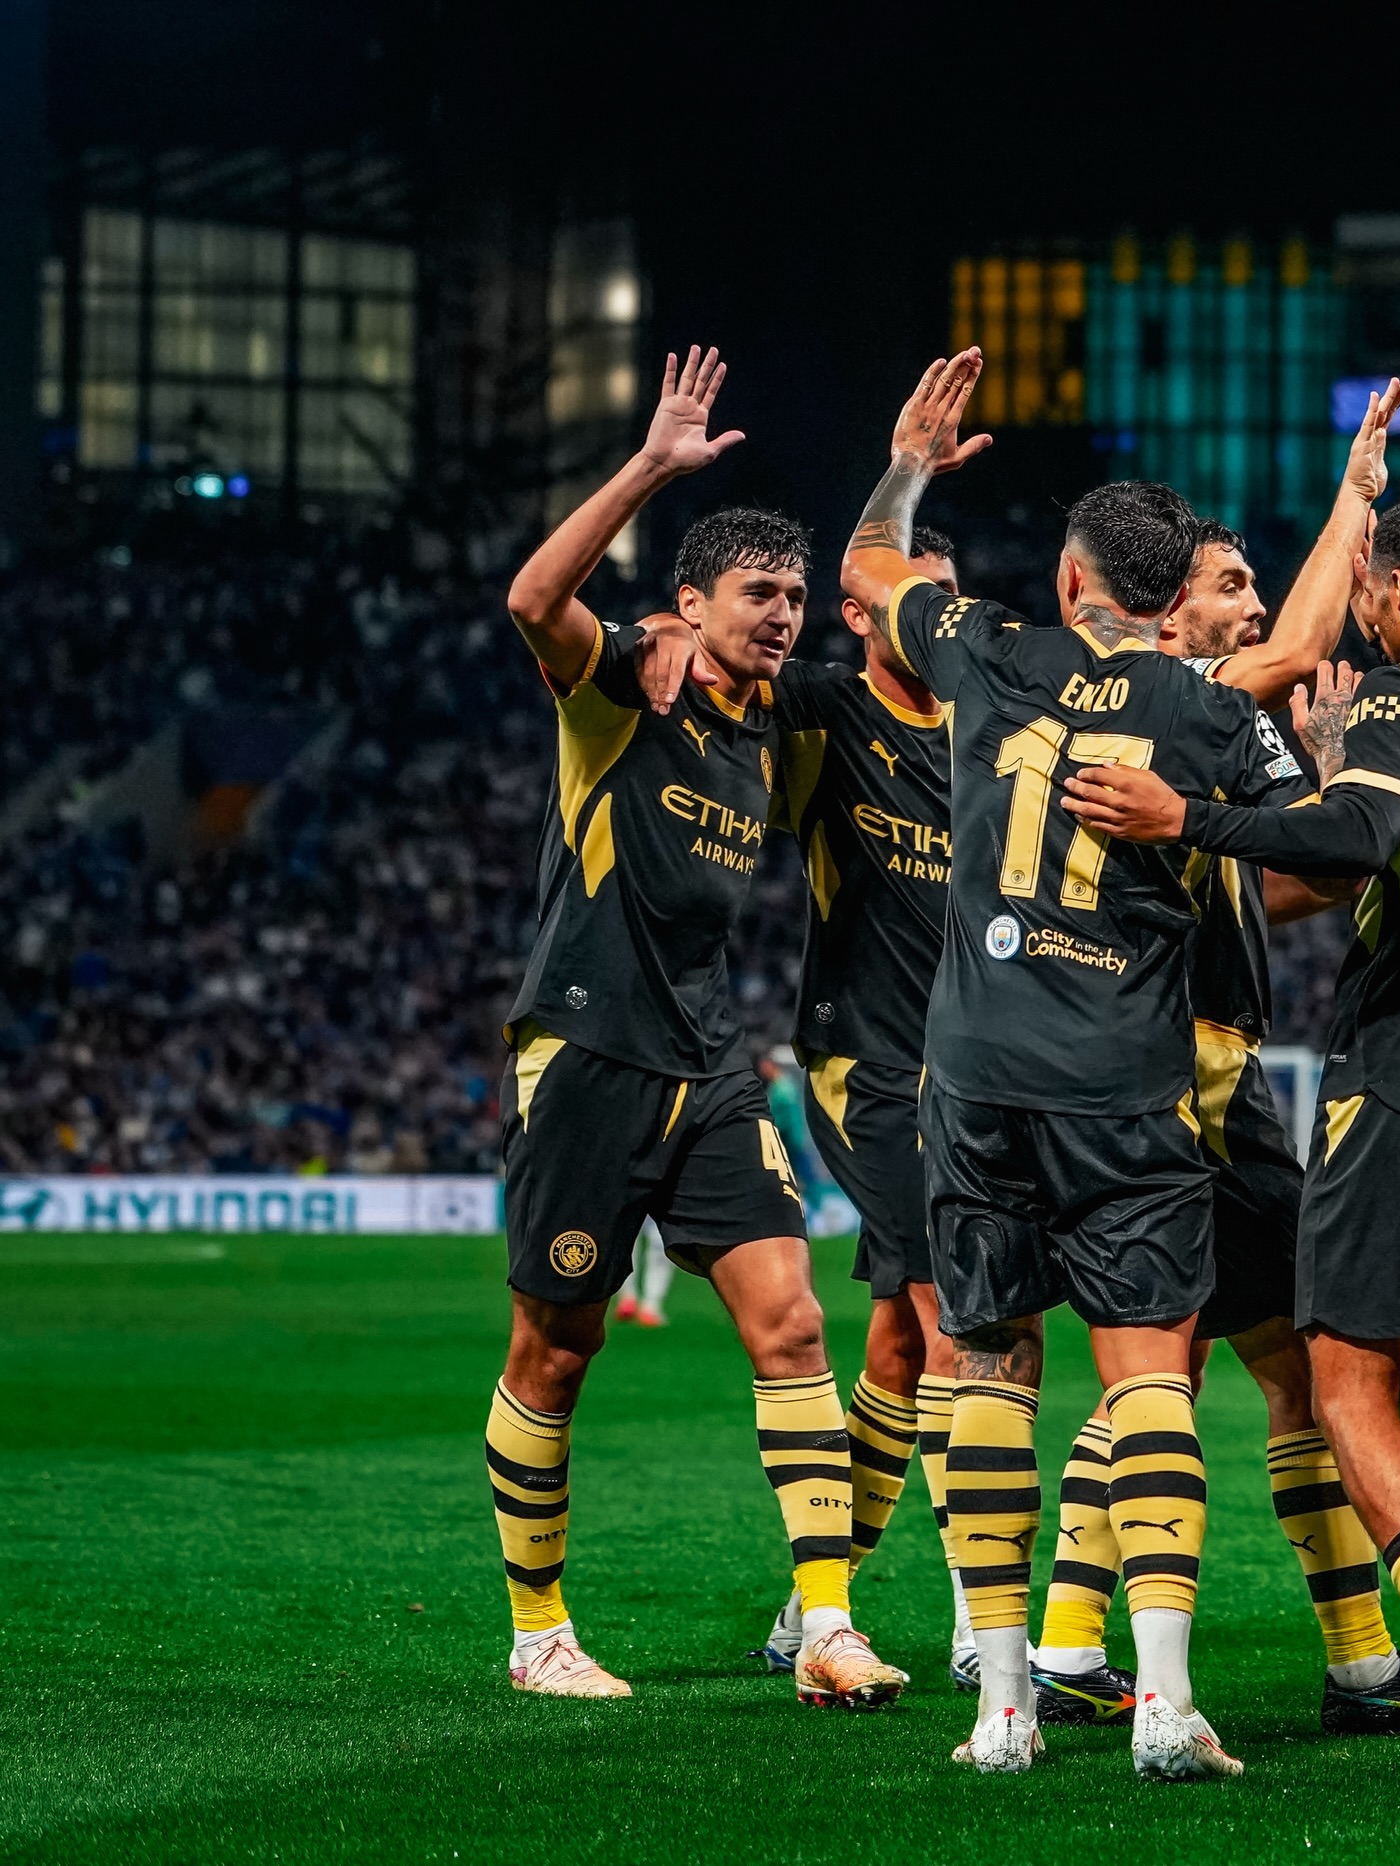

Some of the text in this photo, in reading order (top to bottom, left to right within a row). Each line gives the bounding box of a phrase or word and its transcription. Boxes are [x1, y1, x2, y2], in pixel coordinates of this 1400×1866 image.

[1058, 673, 1130, 713] ENZO
[661, 784, 766, 848] ETIHA
[853, 804, 952, 857] ETIH
[995, 715, 1155, 912] 17
[888, 854, 952, 884] AIRW
[1026, 931, 1128, 976] Community
[1041, 928, 1099, 953] City in the
[758, 1119, 798, 1188] 4
[83, 1189, 358, 1233] HYUNDAI
[556, 1235, 592, 1248] MANCHESTER
